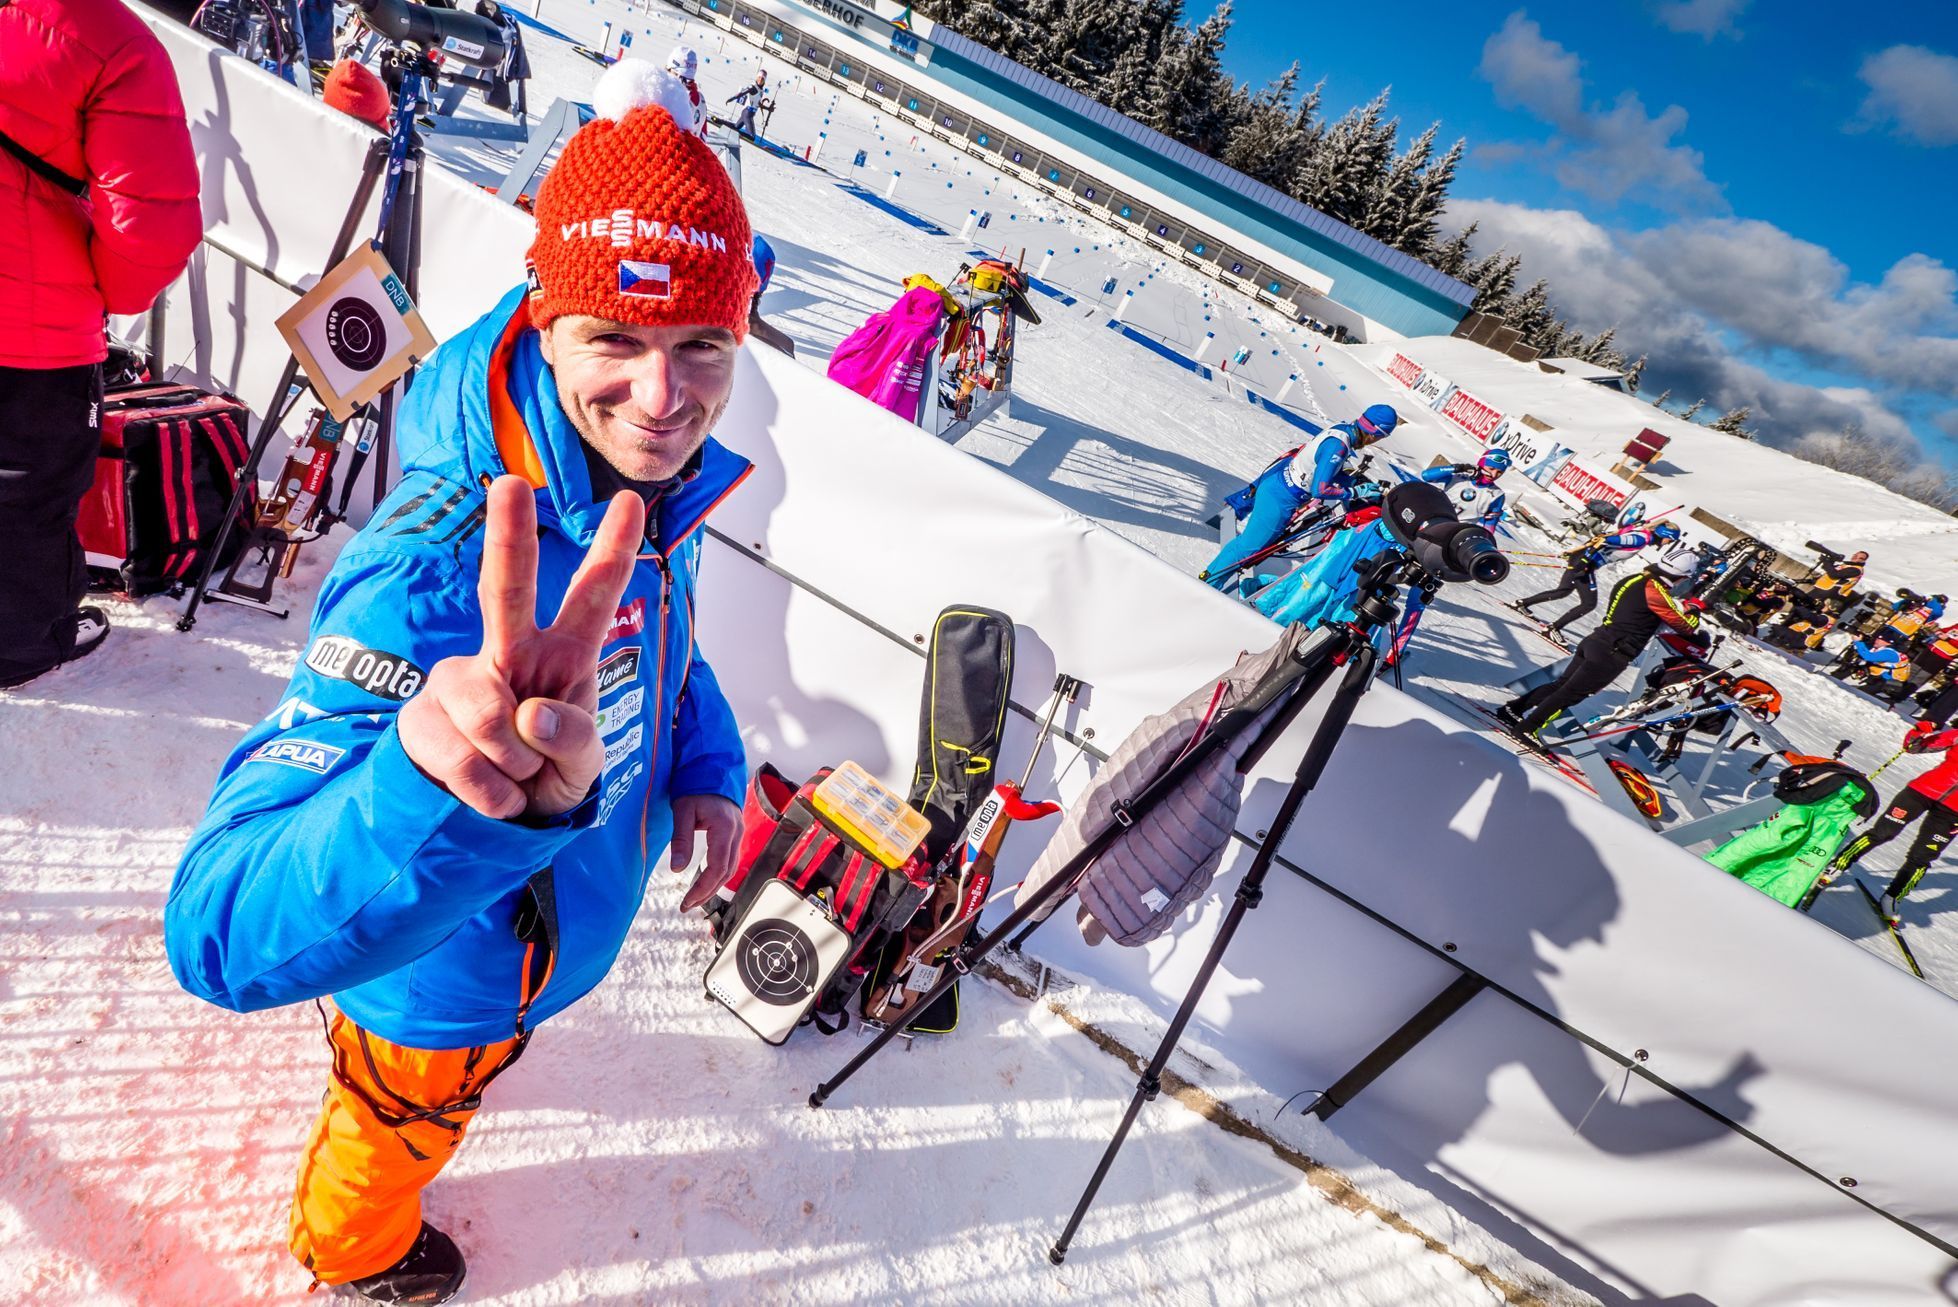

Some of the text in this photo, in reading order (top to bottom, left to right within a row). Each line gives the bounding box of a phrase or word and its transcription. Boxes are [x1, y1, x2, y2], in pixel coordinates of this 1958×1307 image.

[560, 209, 727, 254] VIESSMANN
[385, 280, 405, 307] DNB
[1420, 378, 1440, 400] xDrive
[1446, 393, 1499, 435] BAUHAUS
[1501, 432, 1537, 465] xDrive
[309, 452, 327, 491] VIESSMANN
[612, 692, 640, 718] ENERGY
[260, 744, 326, 768] LAPUA
